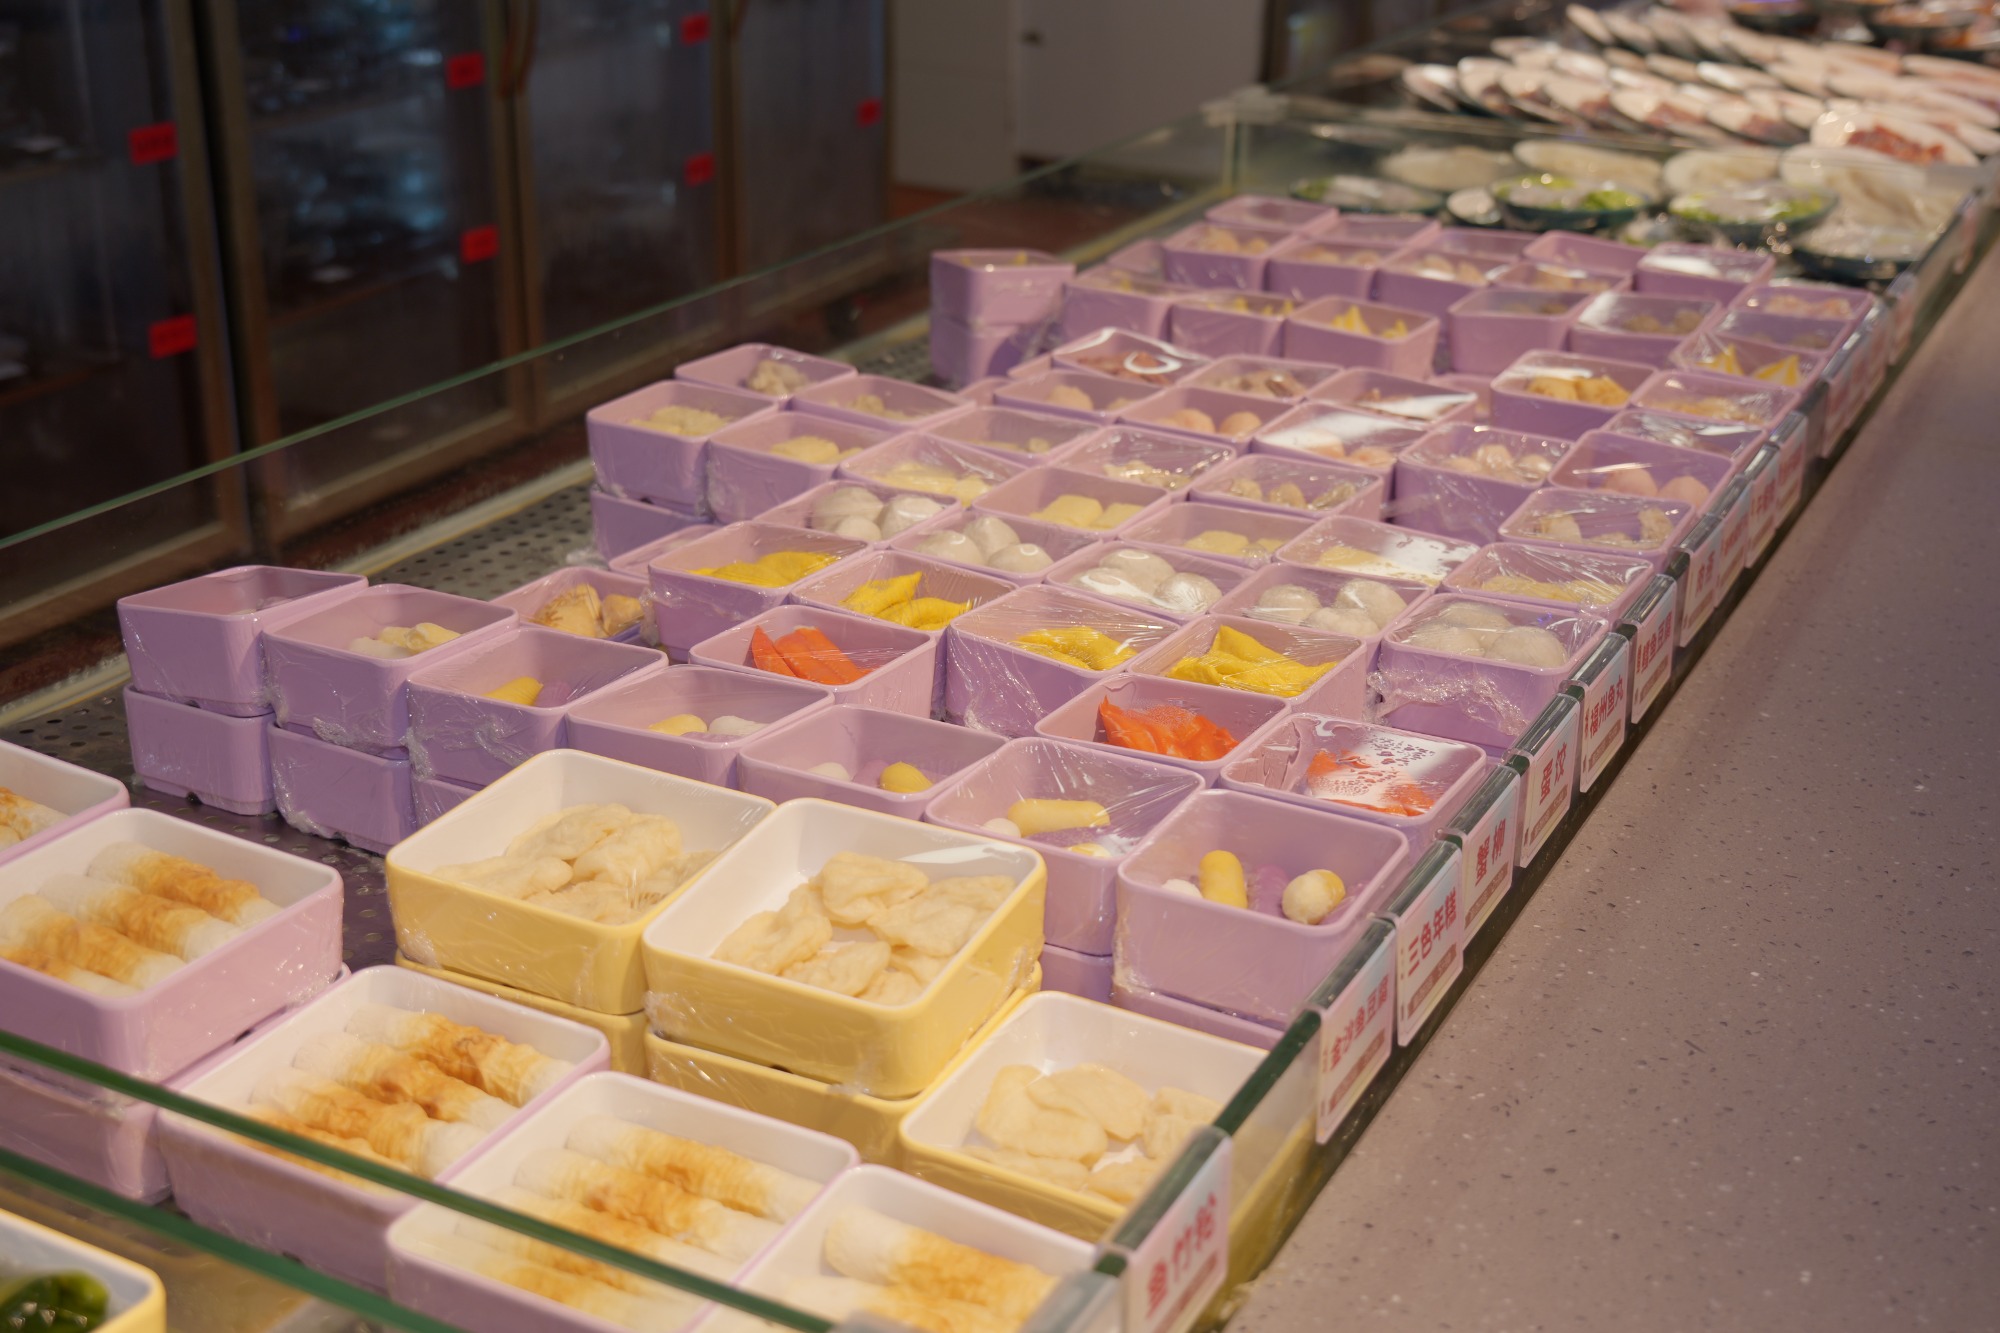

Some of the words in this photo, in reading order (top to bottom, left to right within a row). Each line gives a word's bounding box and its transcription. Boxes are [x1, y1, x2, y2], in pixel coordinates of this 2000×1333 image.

[1590, 674, 1623, 737] 福州鱼丸
[1540, 742, 1568, 805] 蛋饺
[1475, 819, 1506, 887] 蟹柳
[1408, 887, 1457, 976] 三色年糕
